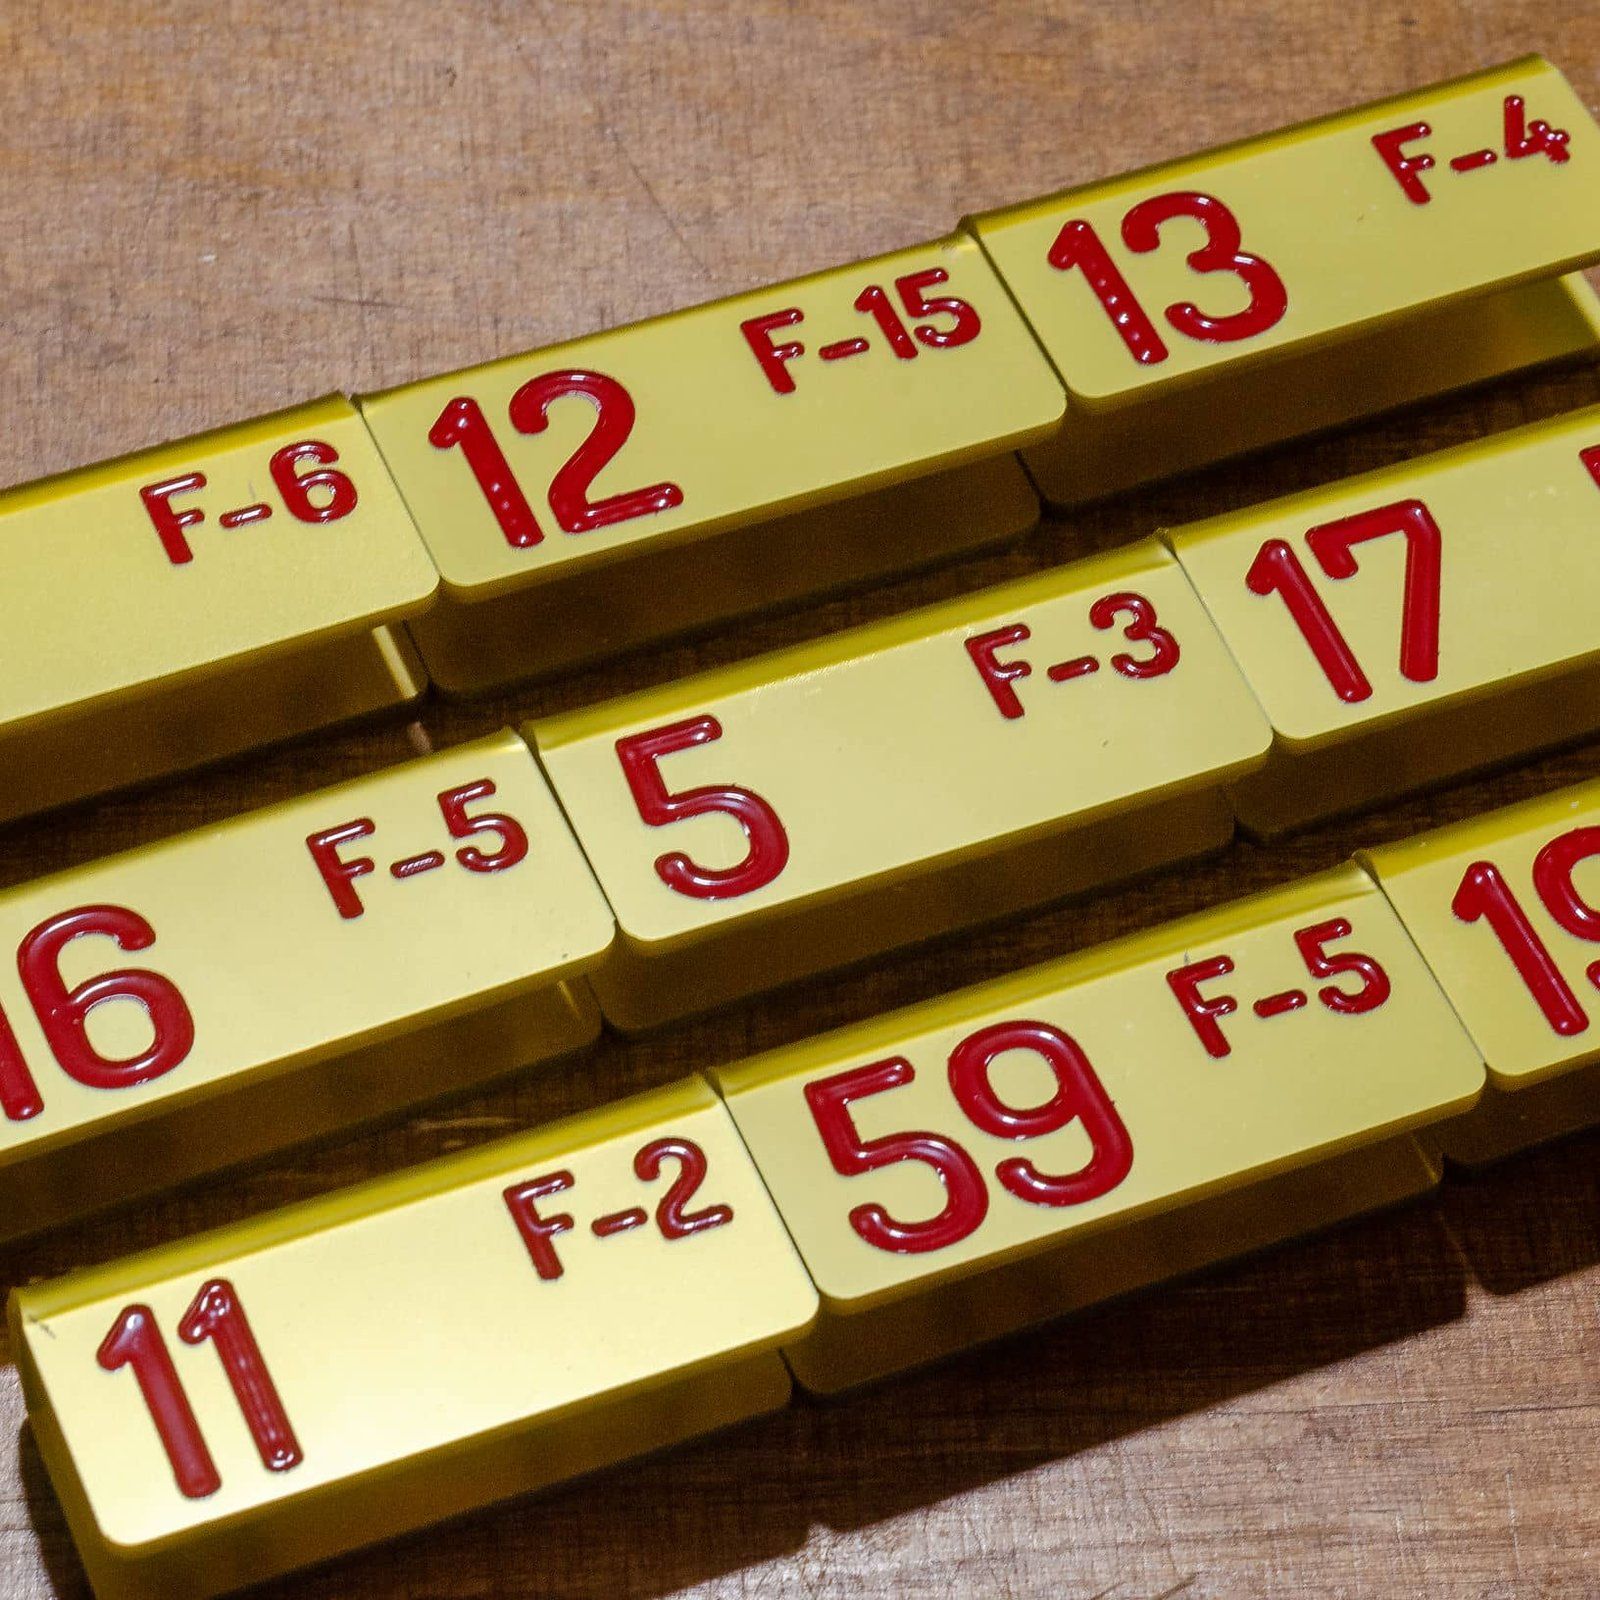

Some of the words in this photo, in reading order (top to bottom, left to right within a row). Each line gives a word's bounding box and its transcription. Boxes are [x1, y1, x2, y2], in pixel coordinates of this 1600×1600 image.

[1372, 95, 1571, 205] F-4
[741, 268, 982, 395] F-15
[1048, 191, 1288, 365] 13
[140, 440, 358, 565] F-6
[428, 369, 684, 549] 12
[965, 592, 1181, 719] F-3
[1246, 498, 1443, 704] 17
[307, 779, 529, 919] F-5
[615, 714, 790, 900] 5
[1166, 917, 1391, 1059] F-5
[803, 1019, 1134, 1255] 59
[503, 1139, 733, 1279] F-2
[97, 1279, 304, 1498] 11
